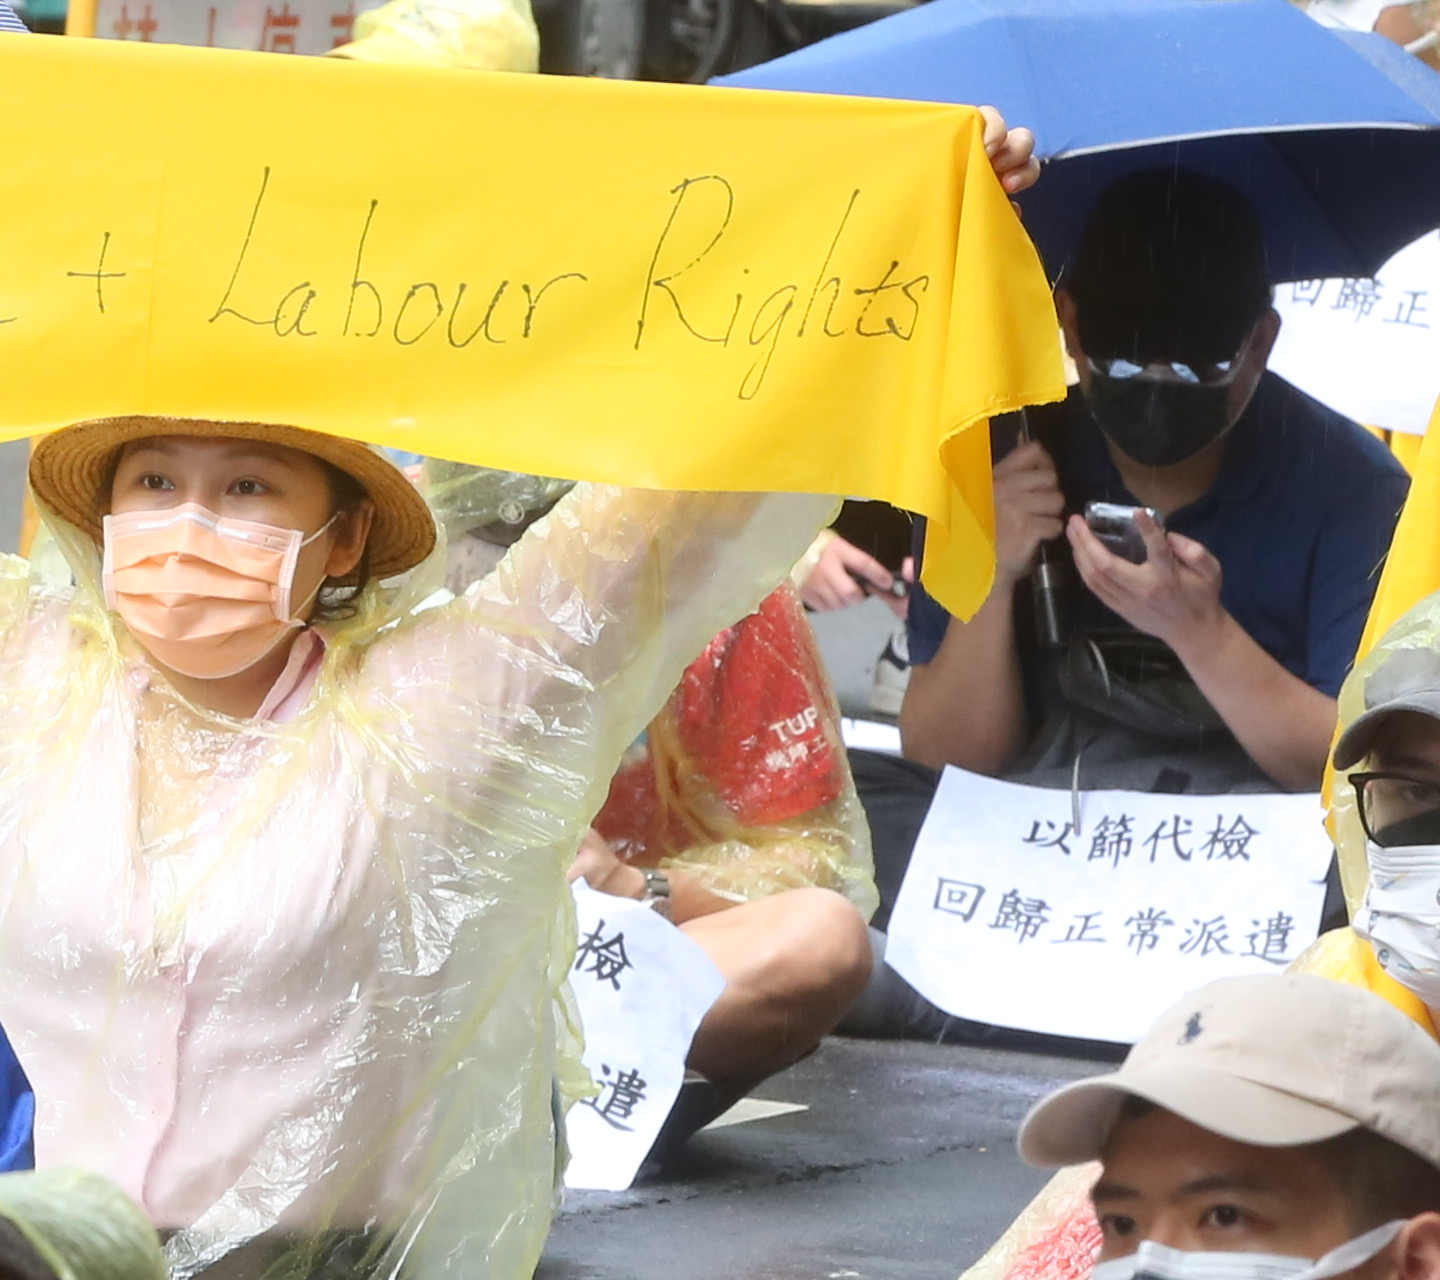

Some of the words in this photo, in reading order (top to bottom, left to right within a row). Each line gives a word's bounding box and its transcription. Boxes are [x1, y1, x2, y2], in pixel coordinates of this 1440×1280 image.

[206, 165, 589, 350] Labour
[632, 174, 932, 401] Rights
[768, 705, 819, 743] TUP
[1023, 813, 1262, 869] 以篩代檢
[575, 918, 634, 991] 檢
[931, 876, 1296, 967] 回歸正常派遣
